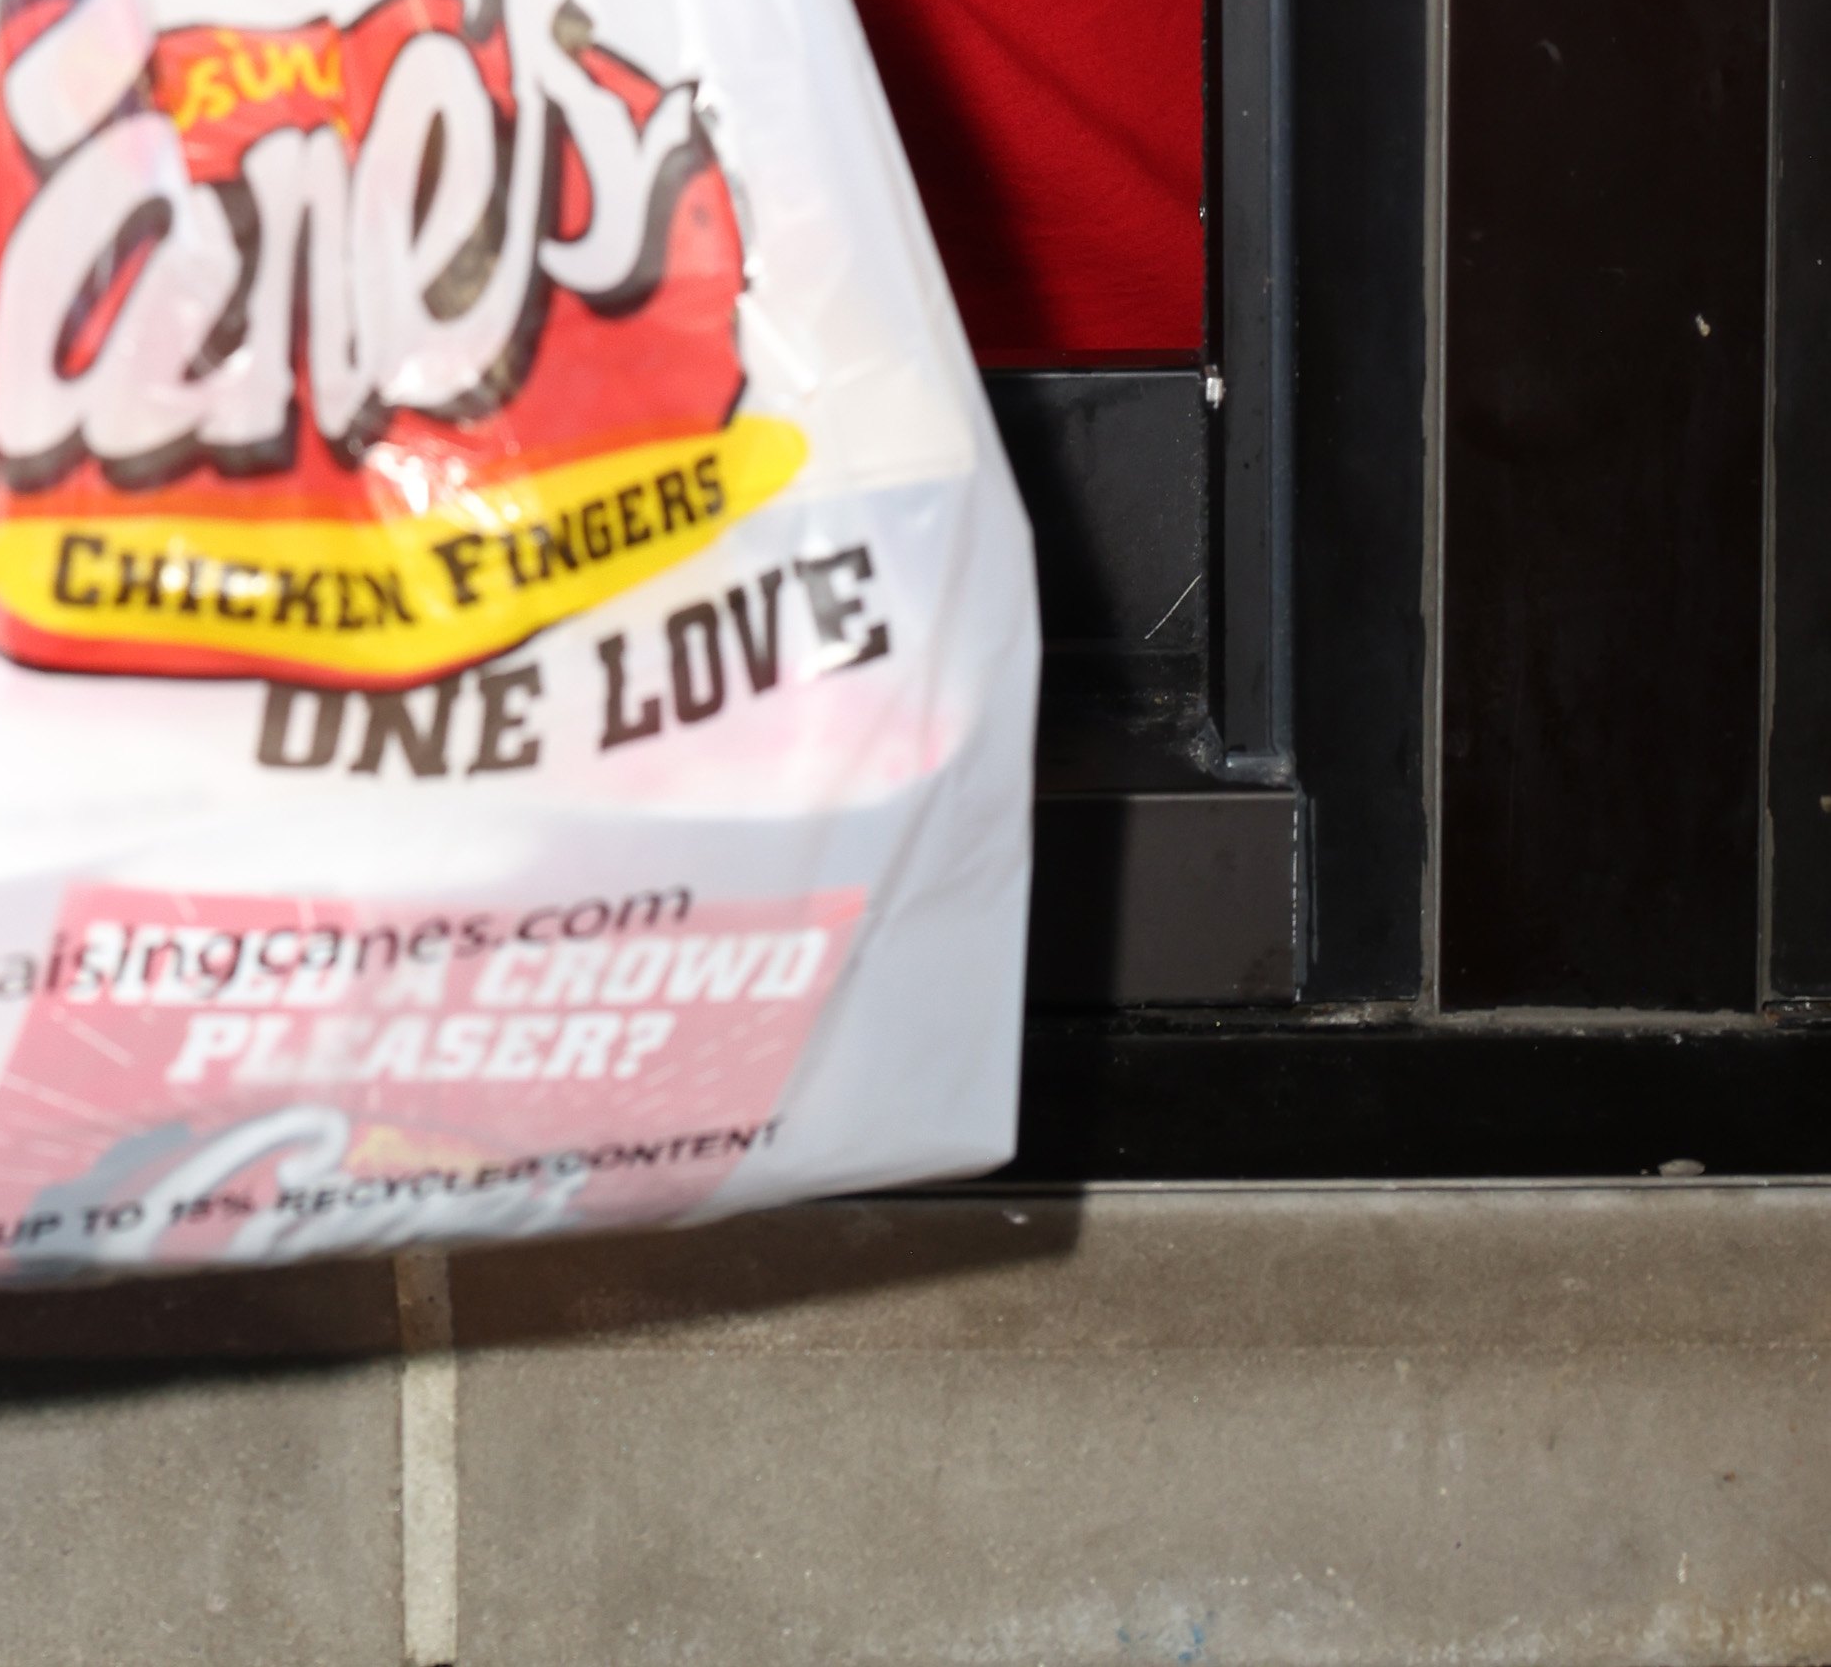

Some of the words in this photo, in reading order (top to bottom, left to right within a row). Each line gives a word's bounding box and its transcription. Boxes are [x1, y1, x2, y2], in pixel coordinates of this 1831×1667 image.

[50, 529, 418, 635] CHICKEN
[432, 453, 728, 609] FINGERS
[254, 665, 549, 779] ONE
[598, 543, 890, 751] LOVE
[472, 925, 832, 1005] CROWD
[166, 1009, 678, 1085] PLEASER?
[80, 1199, 145, 1239] TO
[554, 1117, 785, 1177] CONTENT
